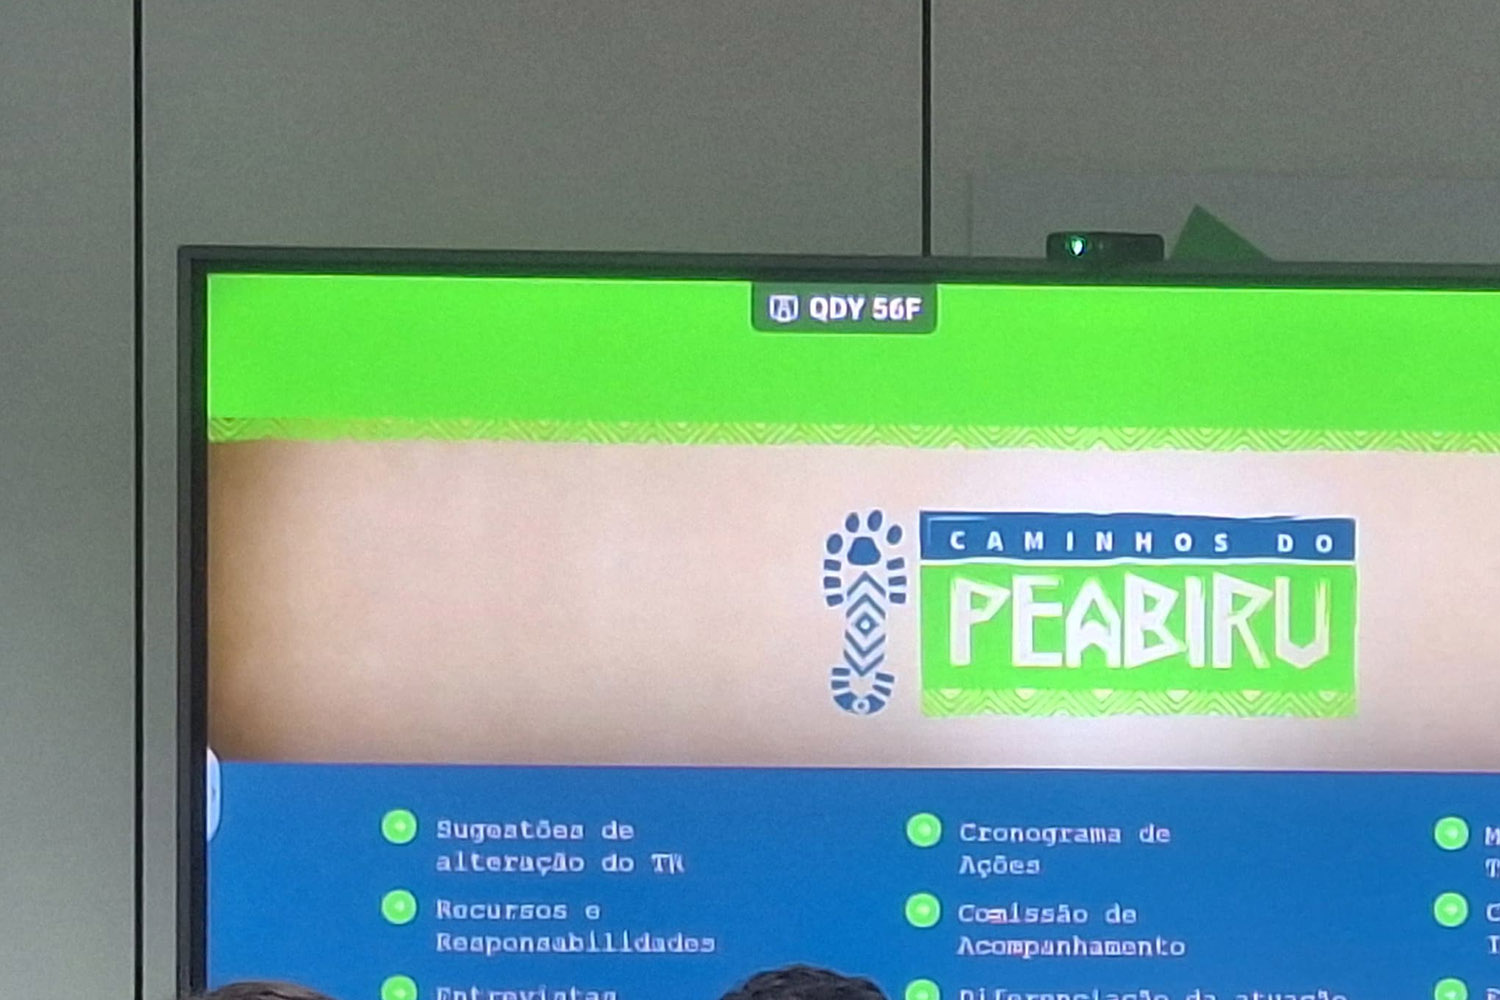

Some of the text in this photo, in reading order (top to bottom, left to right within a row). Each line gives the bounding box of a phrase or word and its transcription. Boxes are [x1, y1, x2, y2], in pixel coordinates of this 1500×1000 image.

[809, 294, 922, 323] QDY 56F
[950, 530, 1333, 553] CAMINHOS DO
[949, 572, 1330, 669] PEABIRU
[437, 819, 634, 844] Sugestões de
[960, 822, 1171, 847] Cronograma de
[436, 850, 585, 876] alteração
[601, 853, 635, 872] do
[959, 854, 1041, 879] Ações
[436, 898, 601, 920] Recursos e
[958, 902, 1137, 925] Comissão de
[436, 930, 715, 957] Responsabilidades
[957, 935, 1185, 960] Acompanhamento
